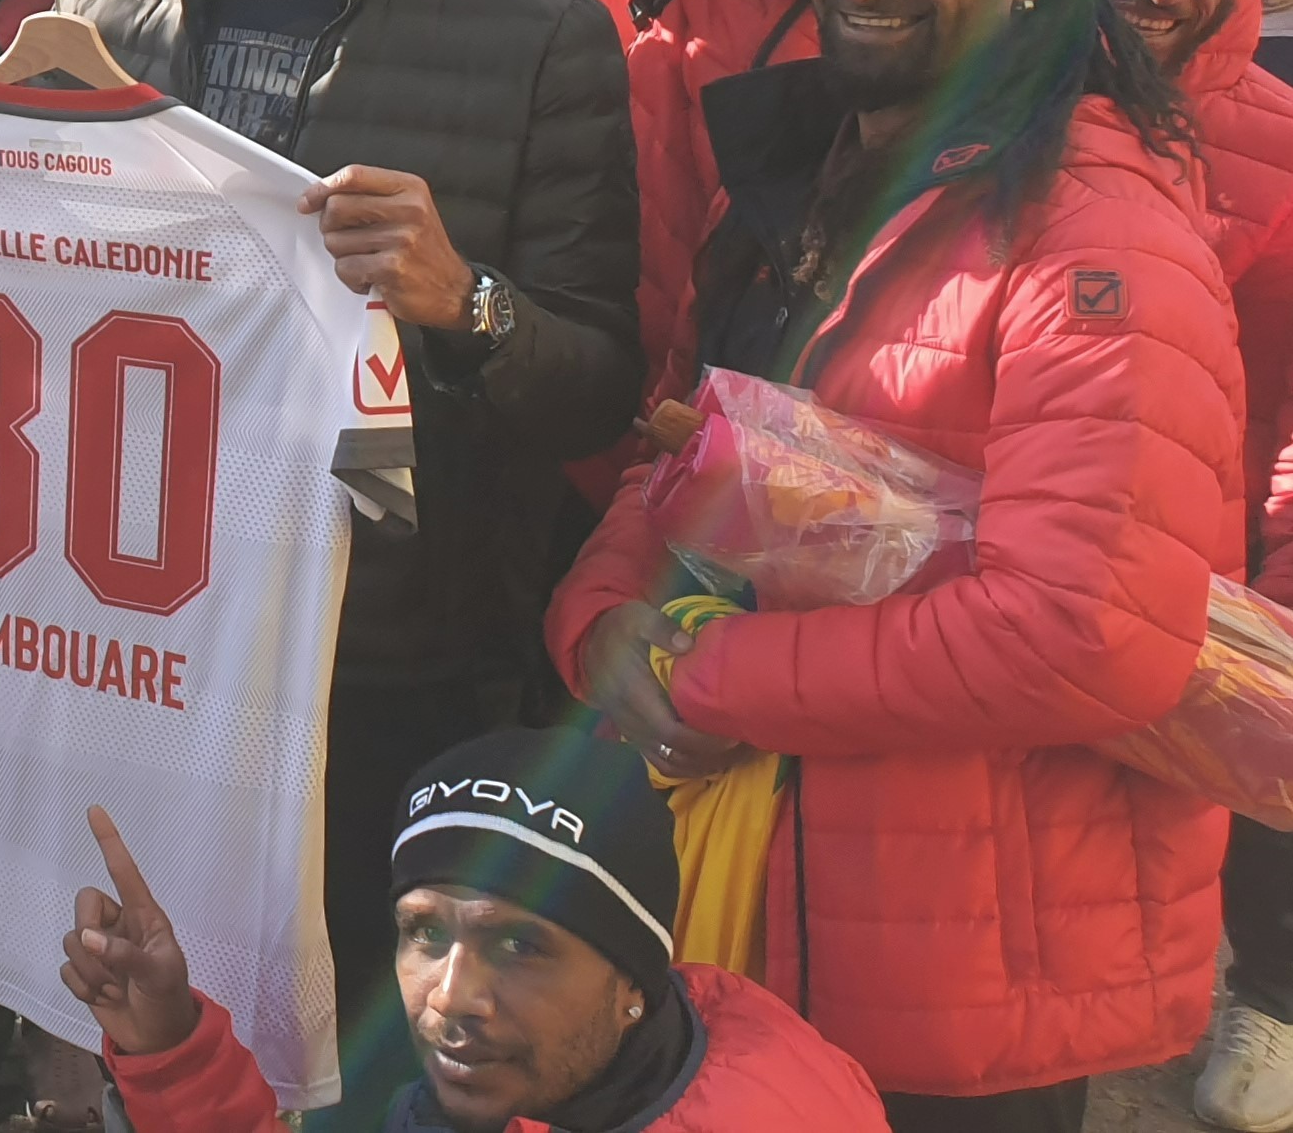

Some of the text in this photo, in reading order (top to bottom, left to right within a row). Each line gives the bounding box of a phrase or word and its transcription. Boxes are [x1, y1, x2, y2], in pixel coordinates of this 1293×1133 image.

[207, 43, 307, 99] KINGS
[44, 152, 113, 176] CAGOUS
[54, 236, 213, 282] CALEDONIE
[409, 778, 584, 844] GIVOVA
